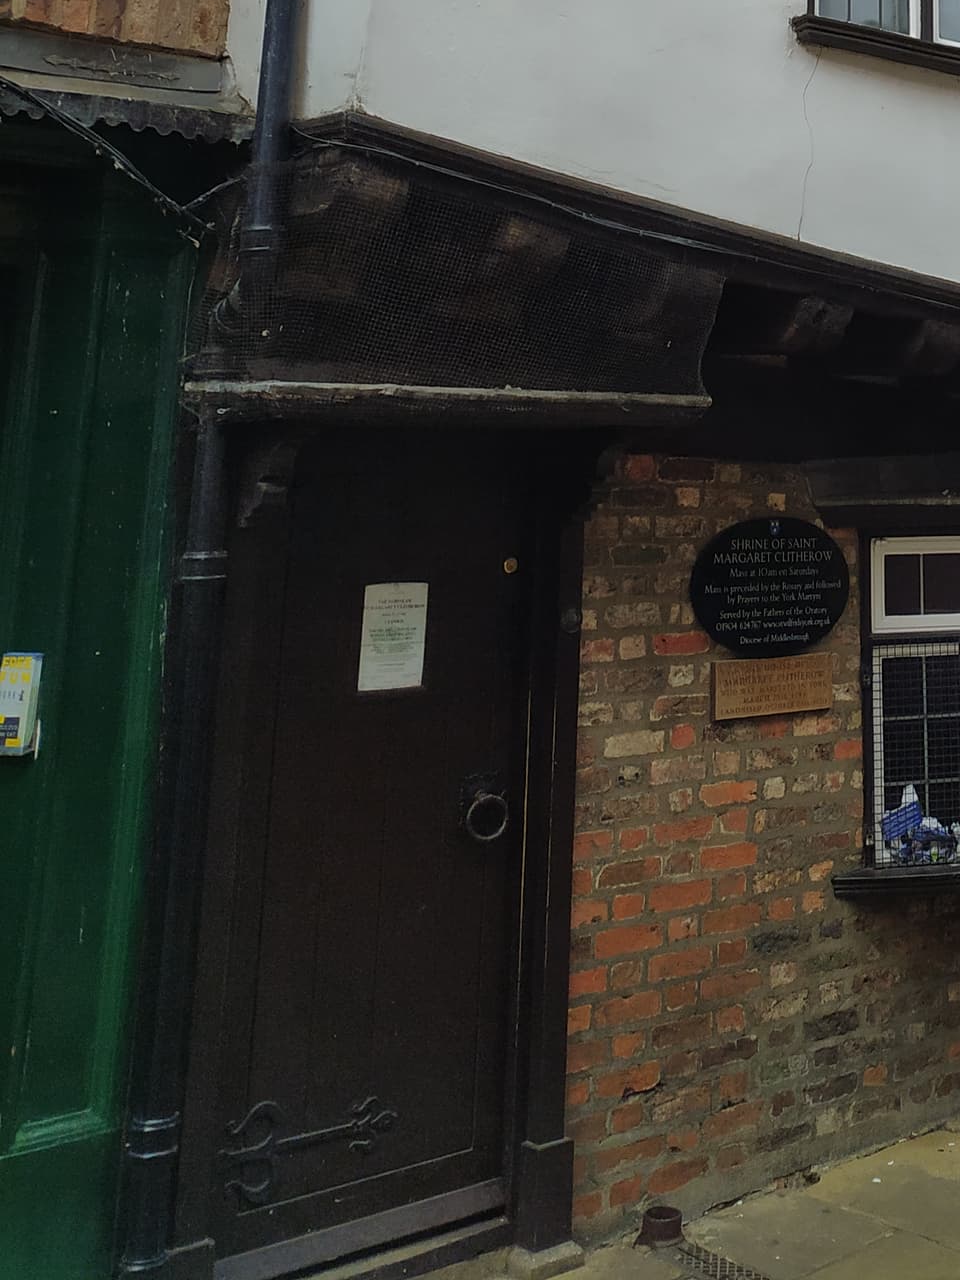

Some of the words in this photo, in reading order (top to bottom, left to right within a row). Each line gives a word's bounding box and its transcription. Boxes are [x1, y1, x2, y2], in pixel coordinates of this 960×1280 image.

[731, 538, 769, 550] SHRINE
[771, 538, 786, 549] OF
[788, 537, 817, 549] SAINT
[713, 552, 772, 564] MARGARET
[774, 551, 833, 562] CLITHEROW
[758, 568, 778, 577] 10am
[789, 567, 818, 577] Saturdays
[730, 584, 759, 596] preceded
[761, 583, 769, 594] by
[770, 583, 780, 591] the
[782, 581, 802, 592] Rosary
[804, 581, 815, 590] and
[816, 579, 841, 589] followed
[727, 595, 735, 606] by
[737, 594, 760, 605] Prayers
[770, 593, 780, 602] the
[782, 593, 796, 601] York
[720, 609, 741, 620] Served
[743, 609, 751, 619] by
[751, 608, 762, 617] the
[763, 607, 785, 617] Fathers
[785, 607, 793, 616] of
[793, 606, 803, 615] the
[805, 605, 827, 616] Oratory
[715, 622, 738, 632] 01904
[740, 636, 762, 645] Diocese
[763, 634, 770, 643] of
[771, 632, 810, 643] Middlesbrough
